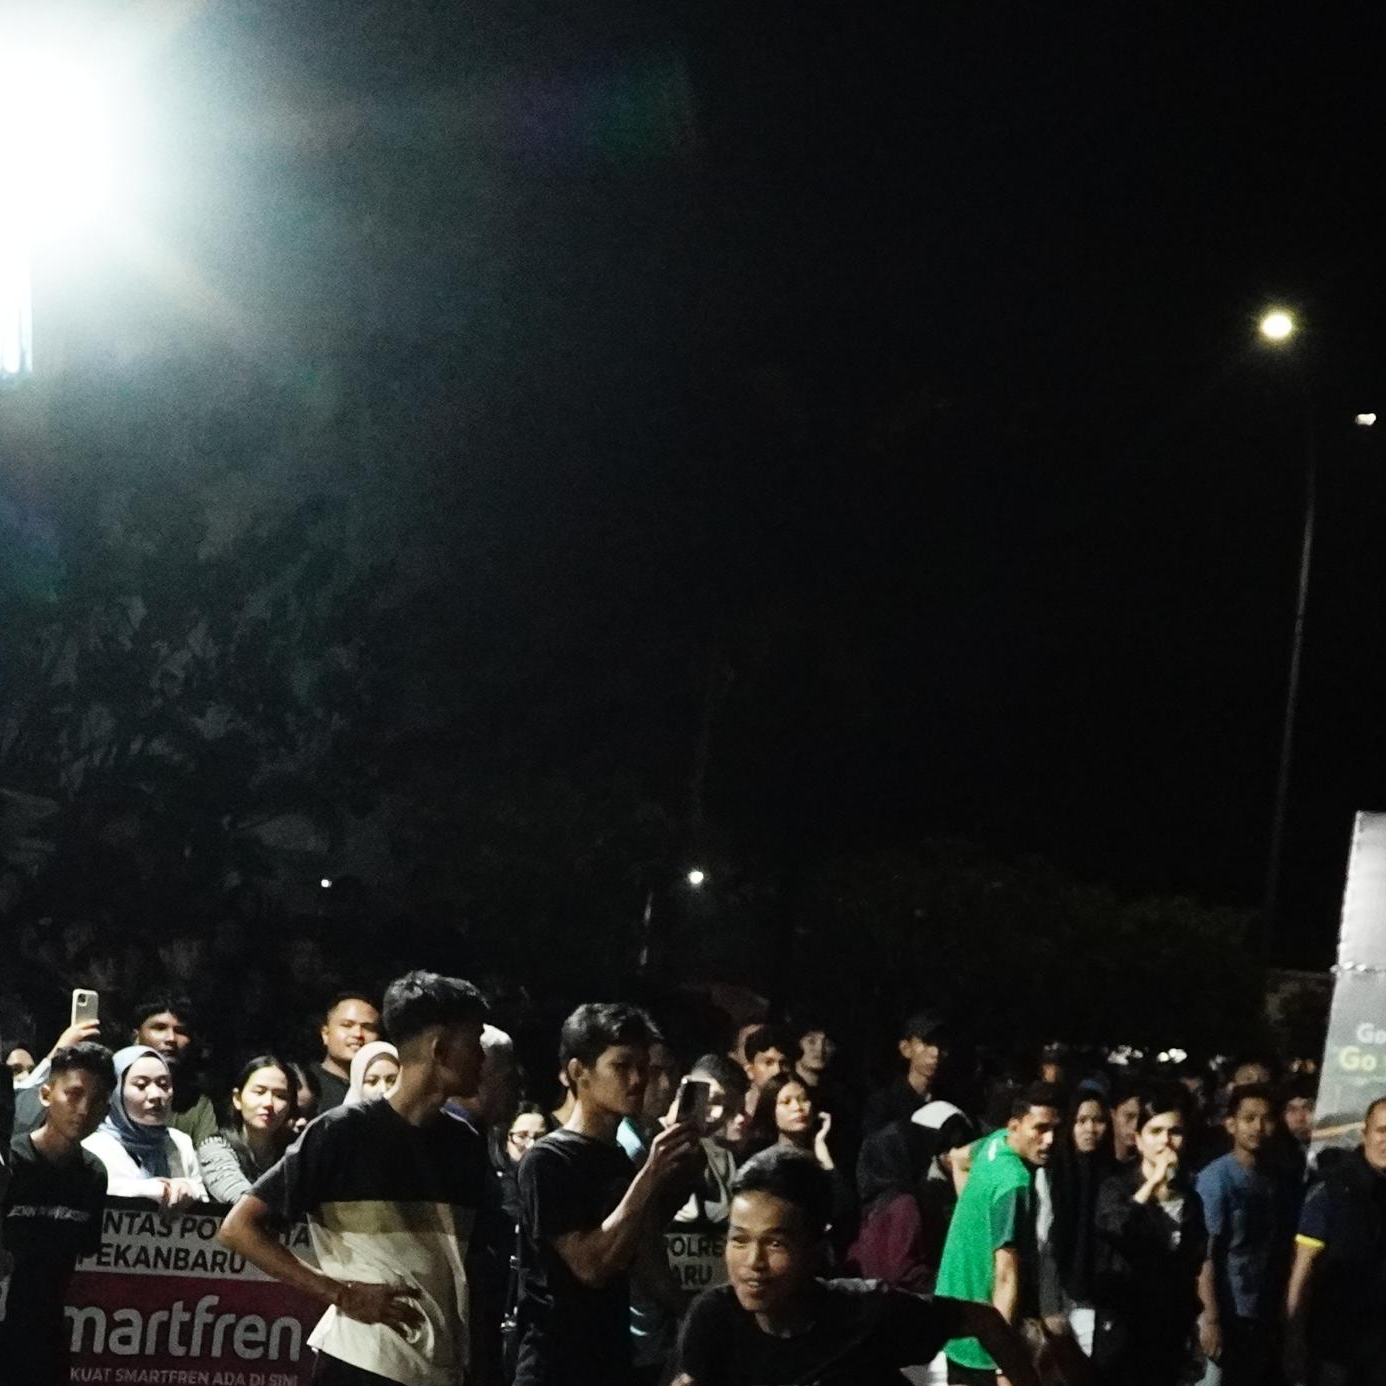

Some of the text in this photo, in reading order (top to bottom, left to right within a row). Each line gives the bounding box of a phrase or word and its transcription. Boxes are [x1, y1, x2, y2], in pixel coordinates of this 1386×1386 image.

[1338, 1045, 1378, 1072] Go
[70, 1367, 111, 1382] KUAT
[115, 1369, 210, 1385] SMARTFREN
[213, 1372, 246, 1386] ADA
[249, 1373, 264, 1386] DI
